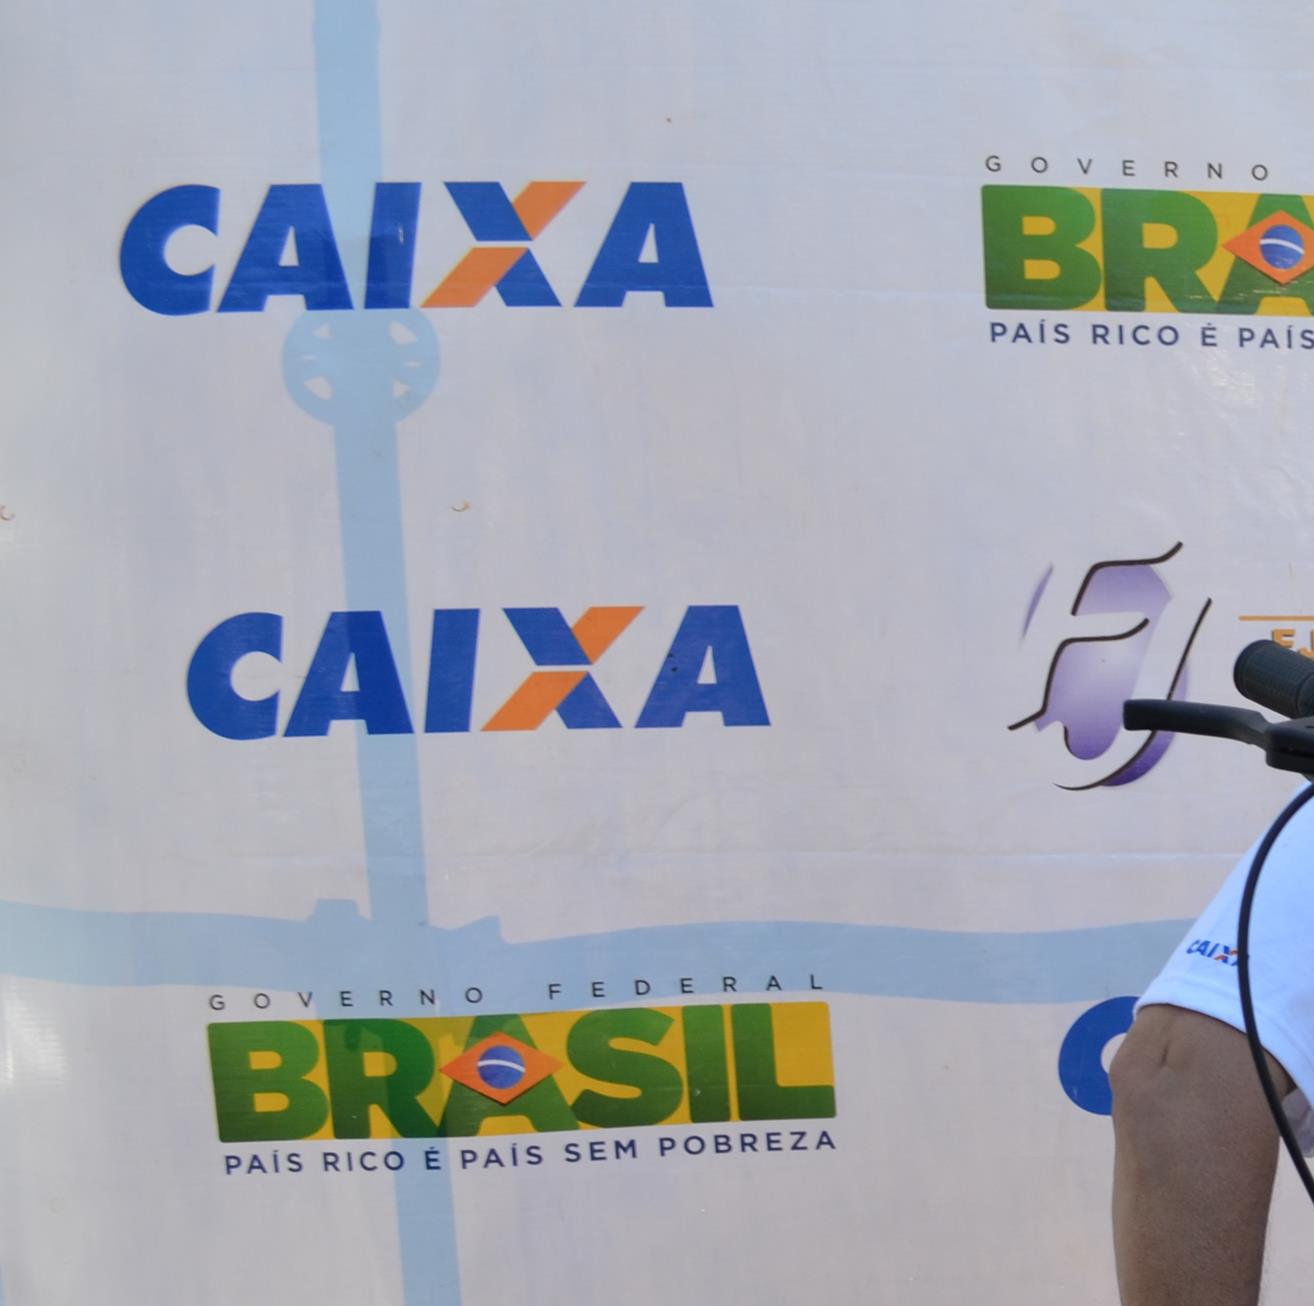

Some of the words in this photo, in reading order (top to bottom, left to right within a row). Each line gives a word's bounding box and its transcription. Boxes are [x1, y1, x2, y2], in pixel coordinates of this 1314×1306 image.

[986, 155, 1269, 182] GOVERNO
[119, 180, 714, 315] CAIXA
[989, 318, 1071, 346] PAÍS
[1091, 323, 1180, 347] RICO
[1201, 324, 1217, 347] É
[186, 604, 772, 741] CAIXA
[1186, 939, 1249, 967] CAIX
[209, 986, 483, 1012] GOVERNO
[549, 975, 823, 1001] FEDERAL
[207, 1001, 837, 1143] BRASIL
[224, 1150, 303, 1176] PAÍS
[322, 1149, 405, 1173] RICO
[424, 1146, 442, 1170] É
[460, 1142, 544, 1169] PAÍS
[564, 1137, 639, 1163] SEM
[658, 1130, 836, 1157] POBREZA
